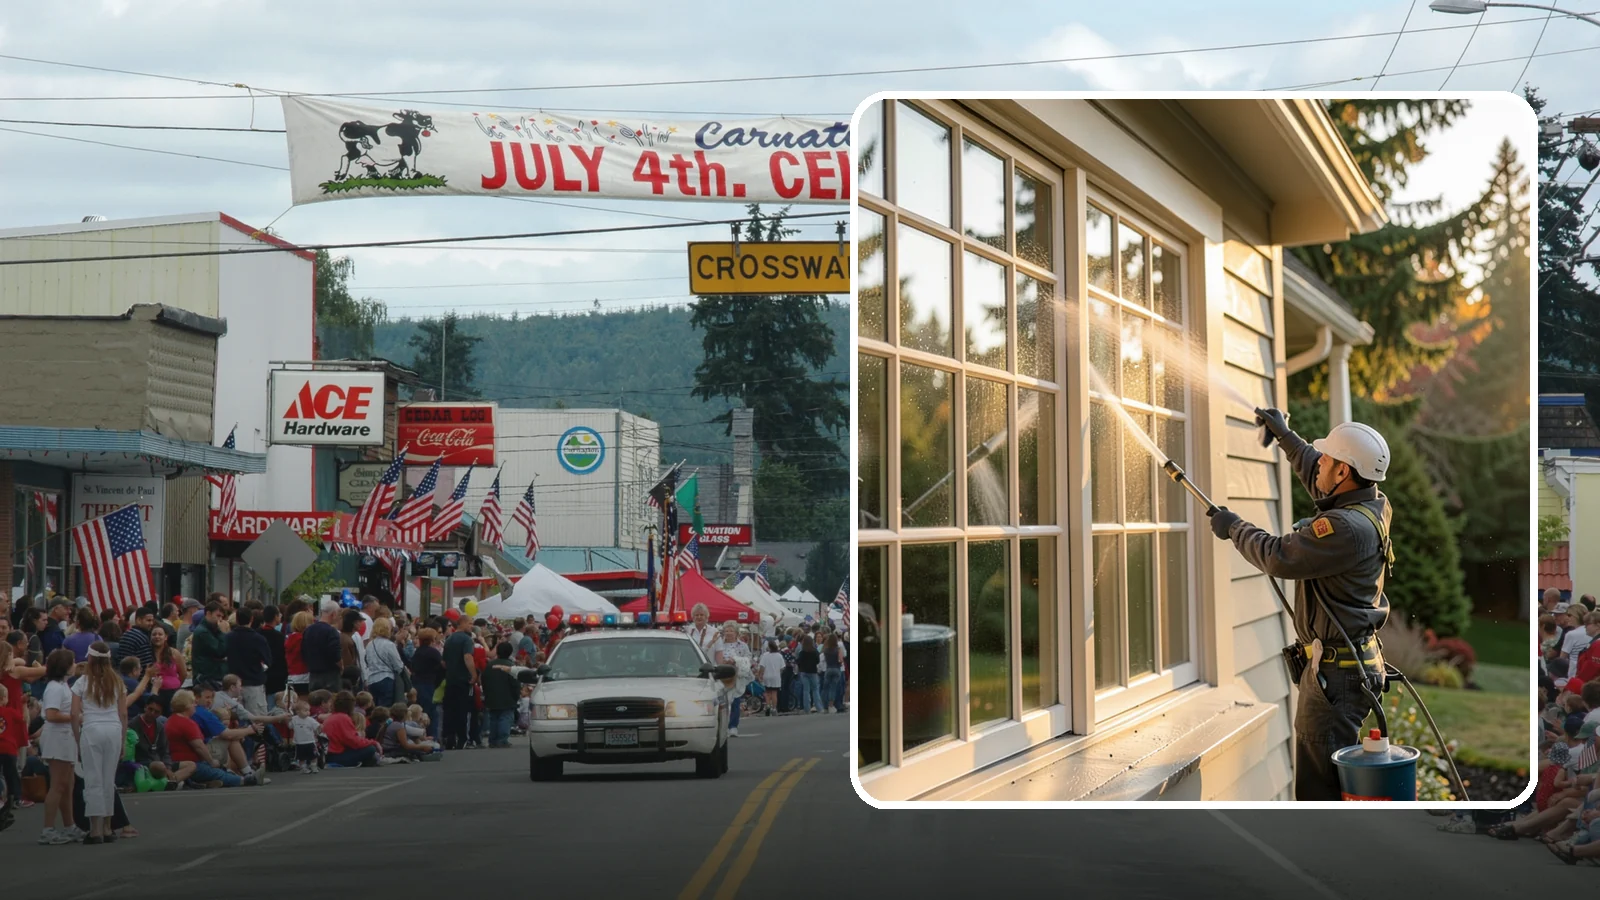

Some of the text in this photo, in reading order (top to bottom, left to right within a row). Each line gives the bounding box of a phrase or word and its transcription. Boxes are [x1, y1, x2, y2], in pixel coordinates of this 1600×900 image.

[695, 121, 850, 150] Carnat
[481, 141, 605, 192] JULY
[632, 150, 746, 197] 4th.
[697, 254, 850, 280] CROSSWA
[283, 380, 373, 419] ACE
[405, 409, 485, 422] CEDAR LOG
[283, 421, 370, 436] Hardware
[416, 428, 477, 447] Coca-Cola
[353, 467, 384, 480] Simpl
[96, 485, 124, 494] Vincent
[126, 486, 135, 494] de
[138, 486, 155, 495] Paul
[213, 516, 331, 535] HARDARE
[688, 526, 741, 535] CRNATION
[699, 535, 730, 543] GLASS
